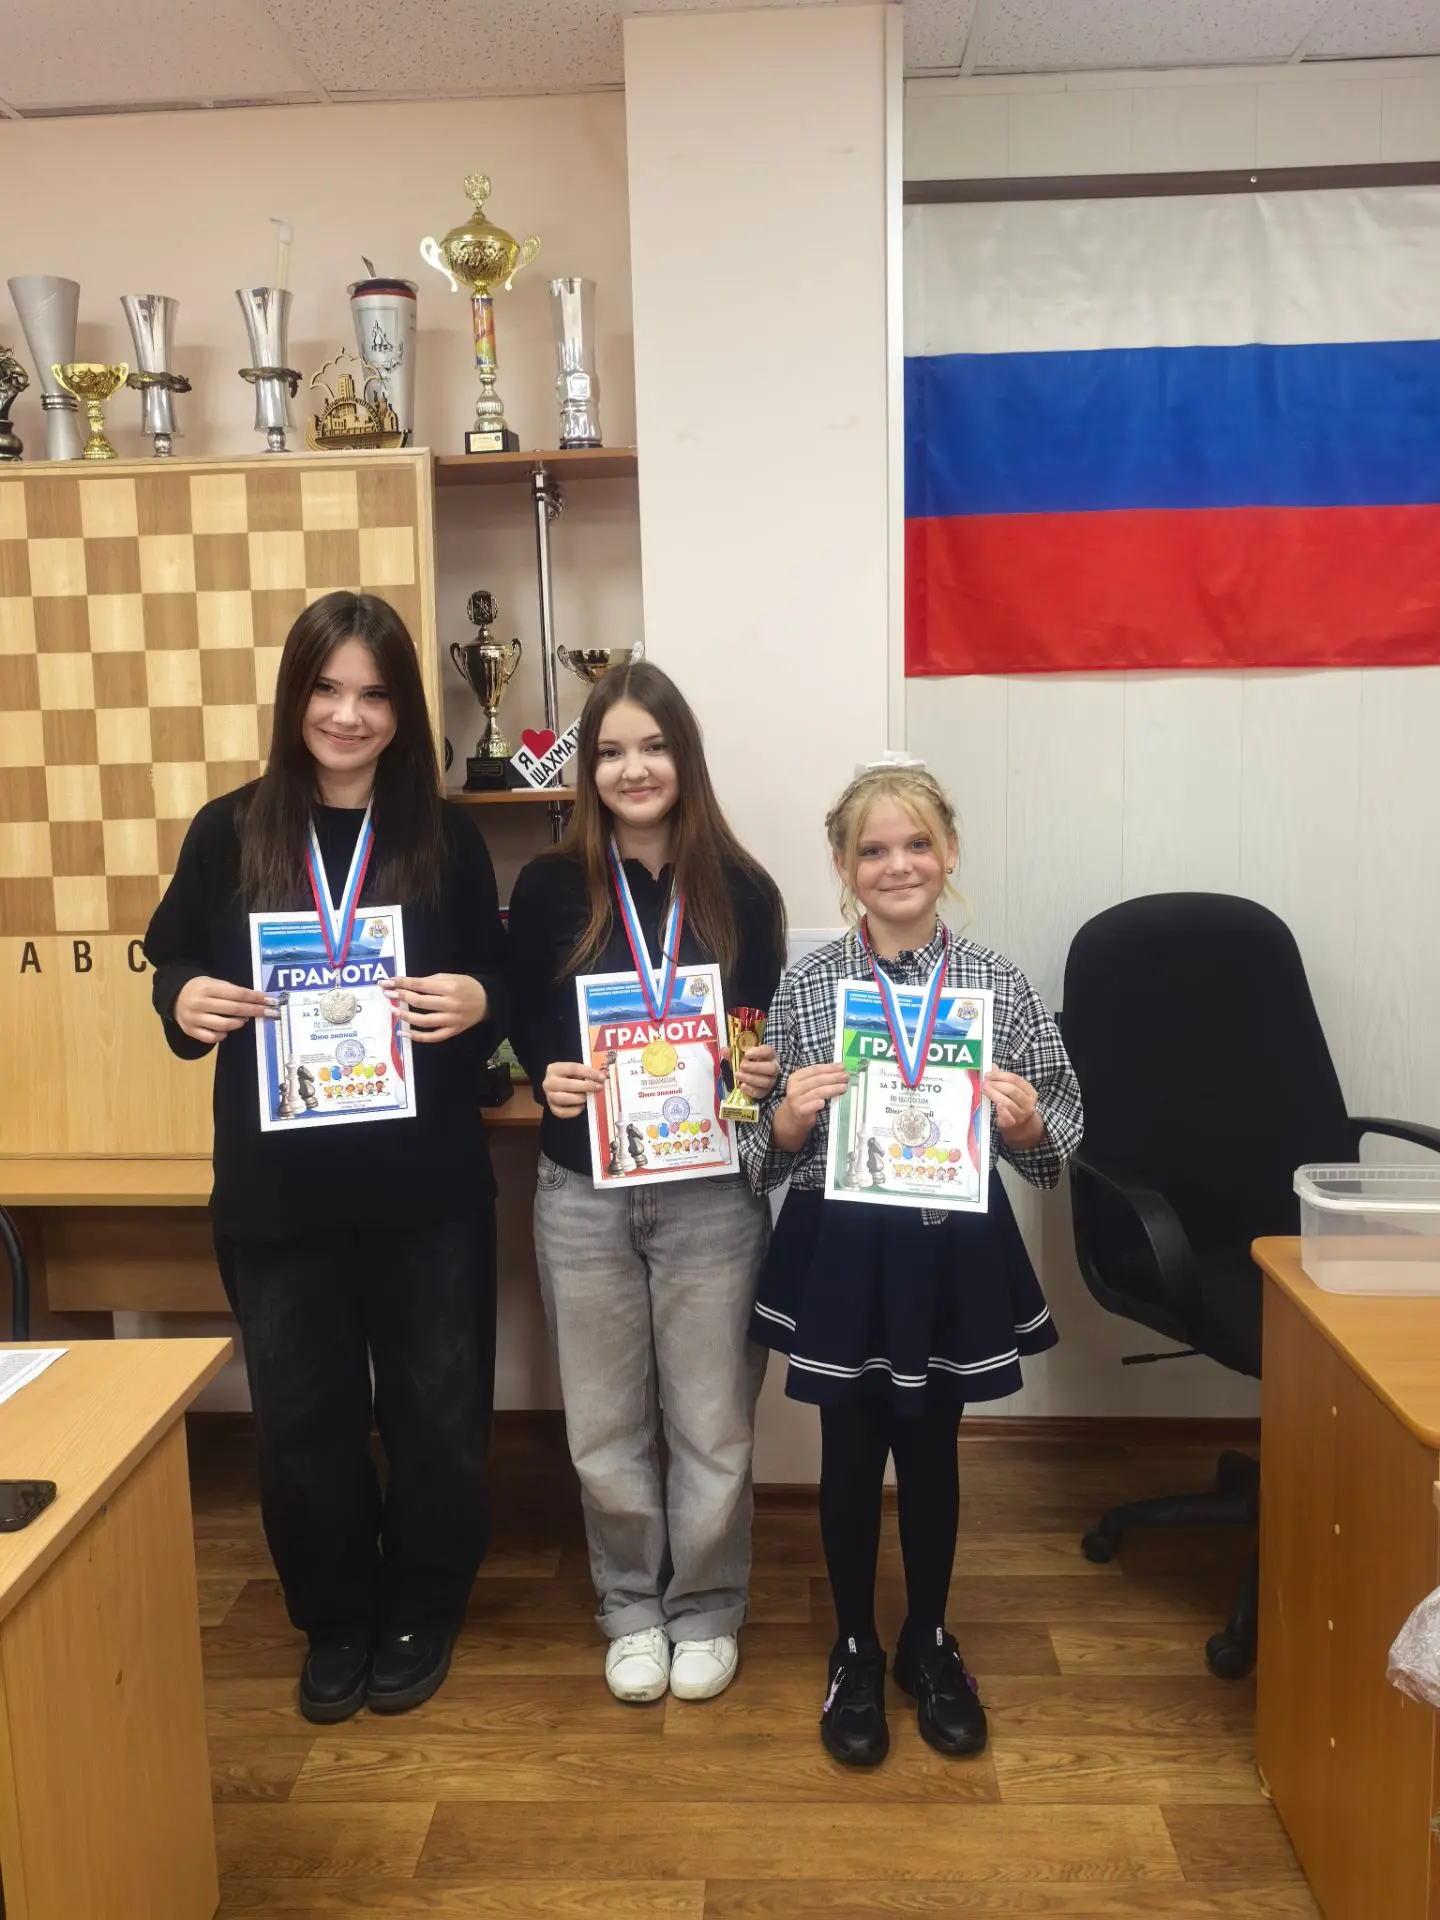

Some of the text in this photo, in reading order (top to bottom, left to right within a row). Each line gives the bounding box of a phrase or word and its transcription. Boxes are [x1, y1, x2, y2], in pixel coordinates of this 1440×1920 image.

[518, 751, 534, 770] Я
[20, 939, 147, 973] A B C
[277, 962, 390, 988] ГРАМОТА
[313, 1007, 320, 1017] 2
[605, 1019, 714, 1047] ГРАМОТА
[859, 1036, 974, 1064] ГРАОТА
[640, 1065, 646, 1074] 1
[891, 1080, 897, 1090] 3
